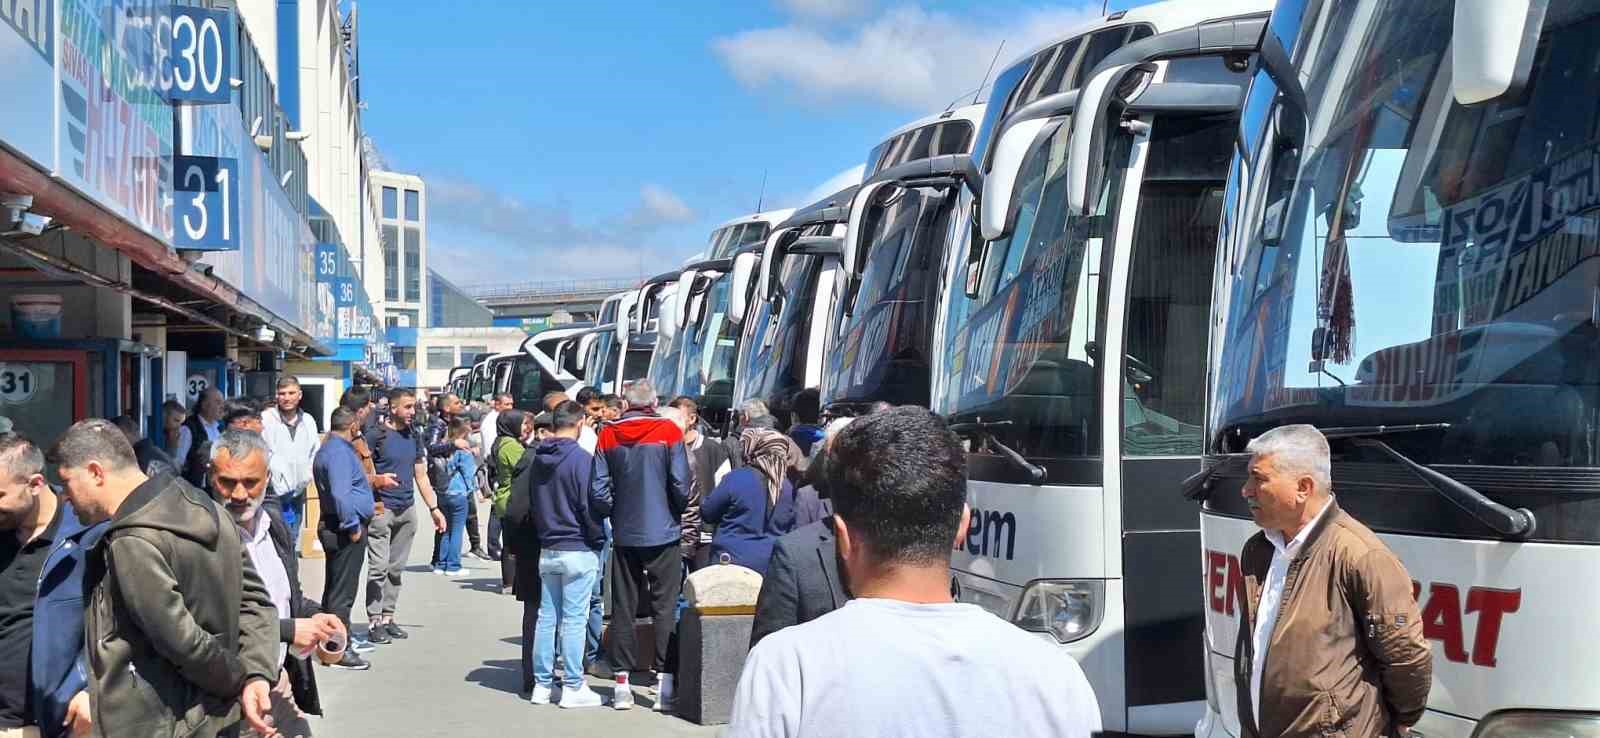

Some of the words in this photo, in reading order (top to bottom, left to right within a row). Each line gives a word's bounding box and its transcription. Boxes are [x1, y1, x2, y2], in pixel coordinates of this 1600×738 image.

[173, 15, 223, 94] 30
[183, 165, 230, 240] 31
[320, 251, 336, 275] 35
[340, 282, 353, 302] 36
[1, 372, 30, 393] 31
[1411, 580, 1522, 668] AT
